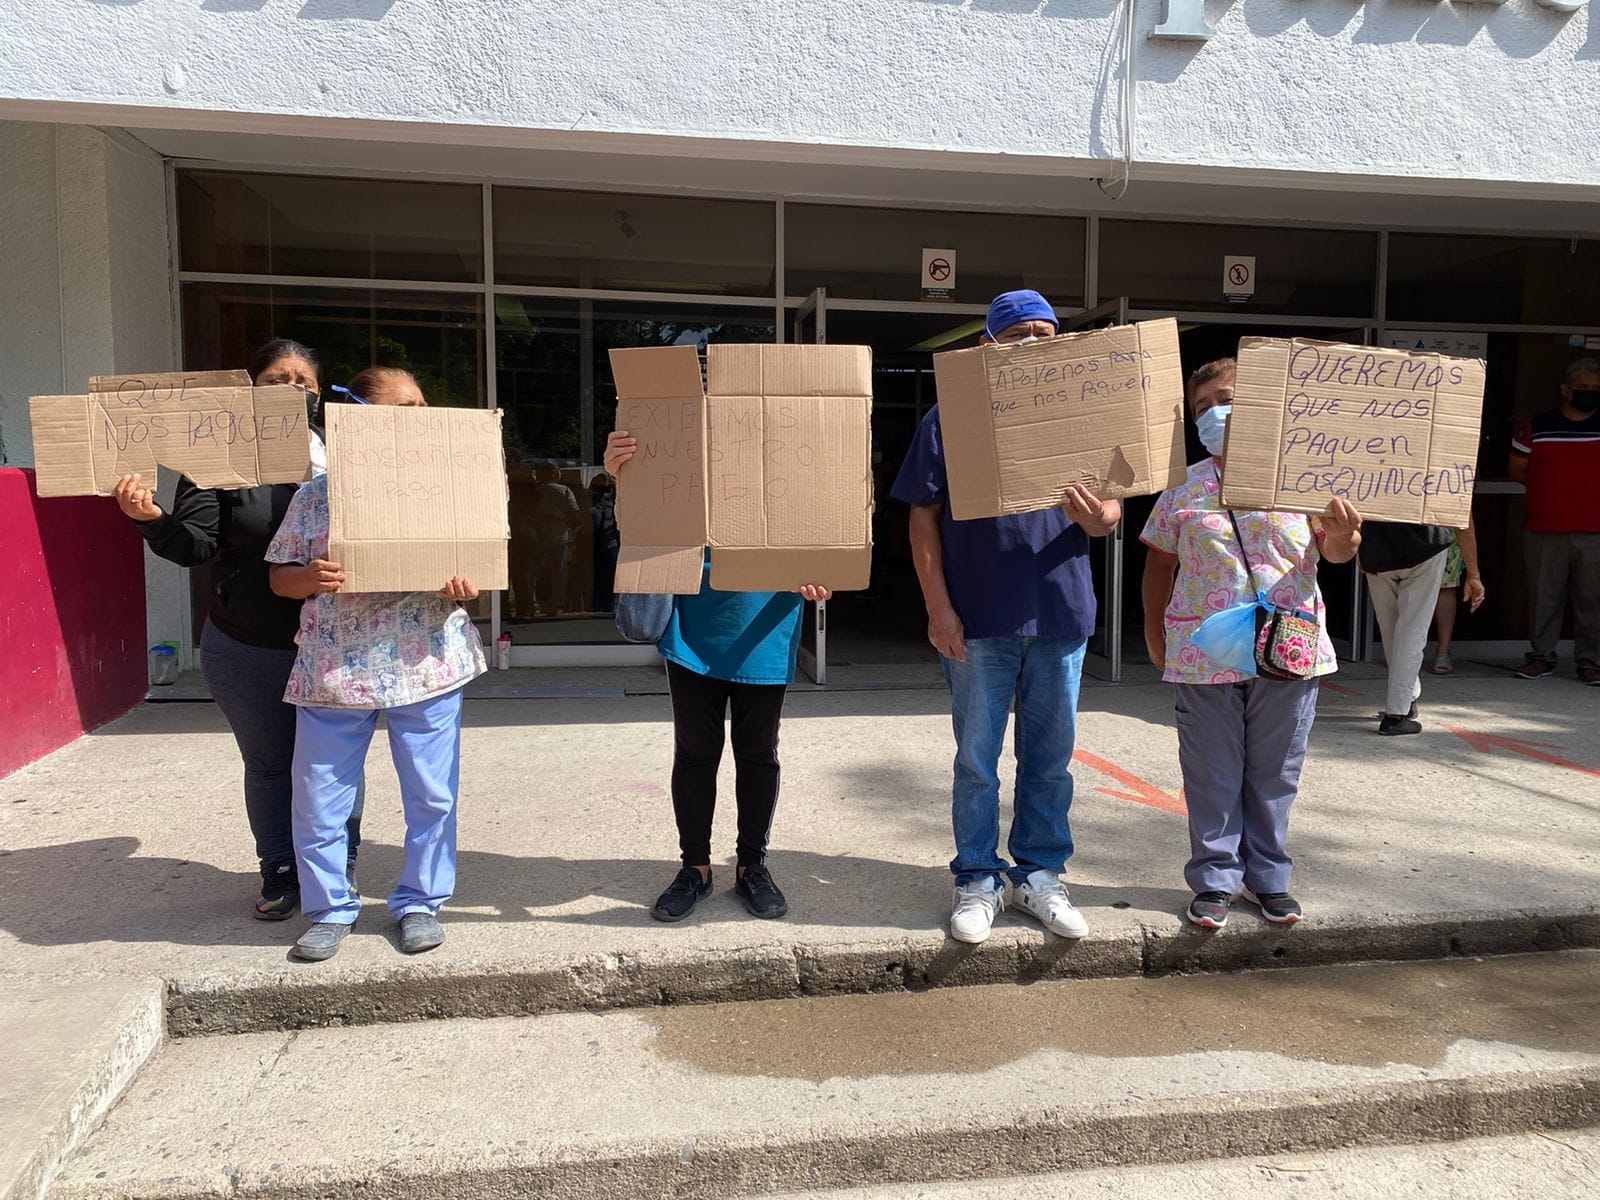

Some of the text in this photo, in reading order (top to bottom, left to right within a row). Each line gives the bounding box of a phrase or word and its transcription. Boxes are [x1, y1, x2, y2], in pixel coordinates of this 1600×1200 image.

[1289, 346, 1464, 391] QUEREMOS
[117, 377, 202, 409] QUE
[991, 400, 1023, 417] que
[1033, 389, 1069, 408] nos
[1288, 392, 1431, 423] QUE NOS
[104, 414, 169, 451] NOS
[416, 415, 444, 436] ya
[626, 402, 798, 432] EXIGIMOS
[641, 439, 815, 467] NUESTRO
[661, 473, 790, 509] PAGO
